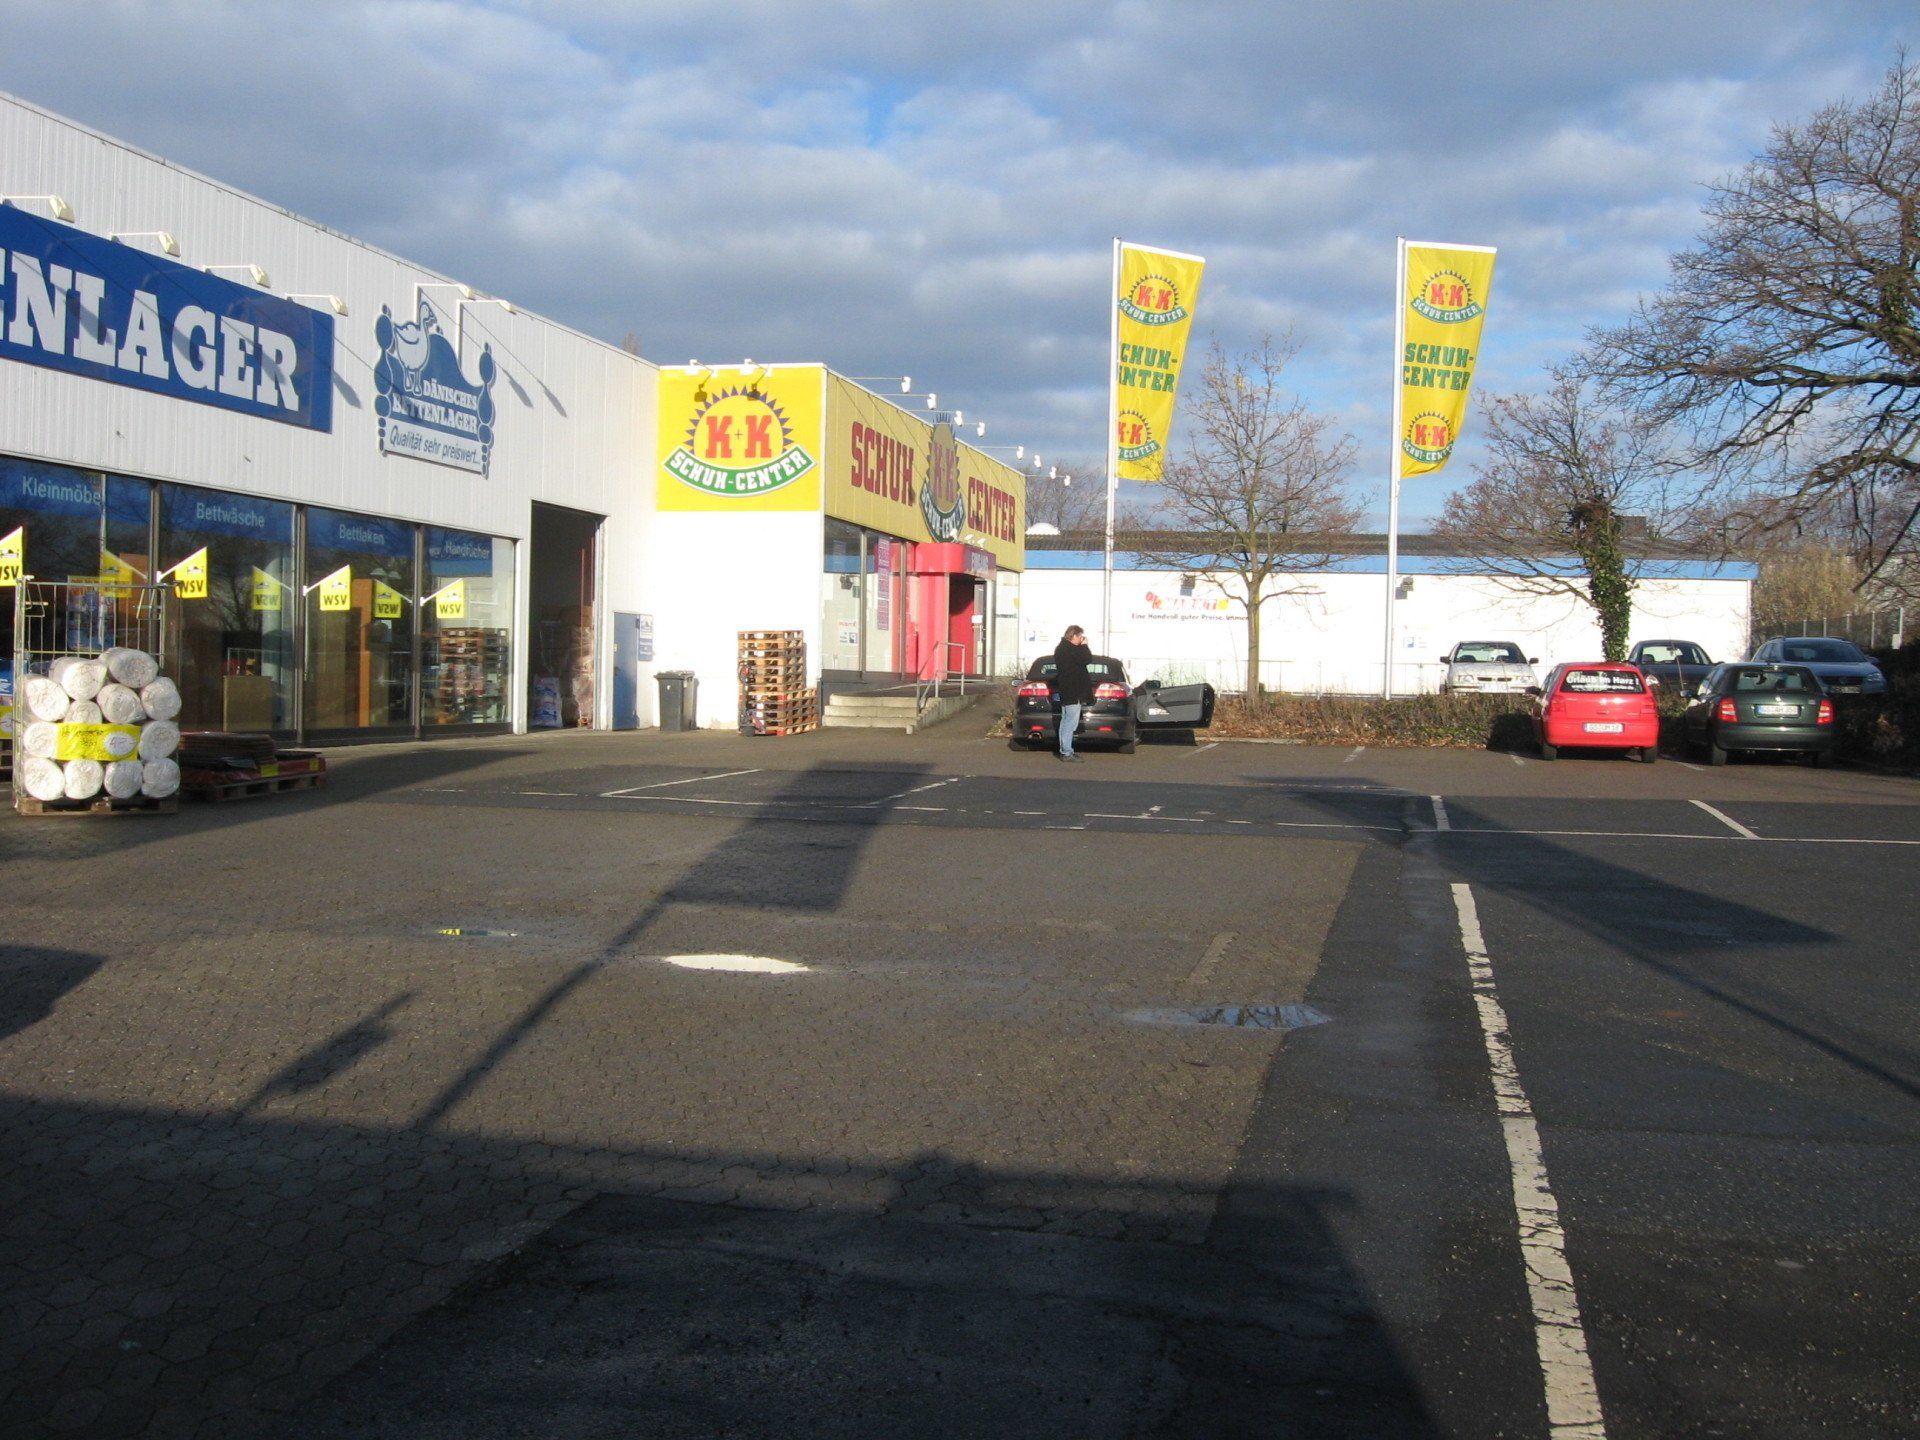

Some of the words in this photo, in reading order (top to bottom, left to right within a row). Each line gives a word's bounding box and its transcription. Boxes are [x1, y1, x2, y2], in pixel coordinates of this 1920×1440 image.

[1120, 300, 1184, 323] SCHUH-CENTER
[1412, 299, 1479, 321] SCHUH-CENTER
[0, 247, 299, 412] NLAGER
[1120, 342, 1178, 370] CHUH-
[1404, 341, 1474, 369] SCHUH-
[1118, 364, 1175, 393] NTER
[423, 378, 478, 411] DÄNISCHES
[392, 392, 478, 435] BETTENLAGER
[390, 424, 422, 452] Qualität
[423, 436, 441, 456] sehr
[669, 450, 808, 491] SCHUH-CENTER
[851, 420, 915, 508] SCHUH
[22, 476, 101, 506] Kleinmöbe
[196, 502, 266, 527] Bettwäsche
[967, 476, 1016, 544] CENTER
[339, 524, 385, 545] Bettlaken
[0, 565, 20, 581] SV
[323, 594, 348, 606] WSV
[439, 604, 462, 615] WSV
[1613, 676, 1634, 685] Harz
